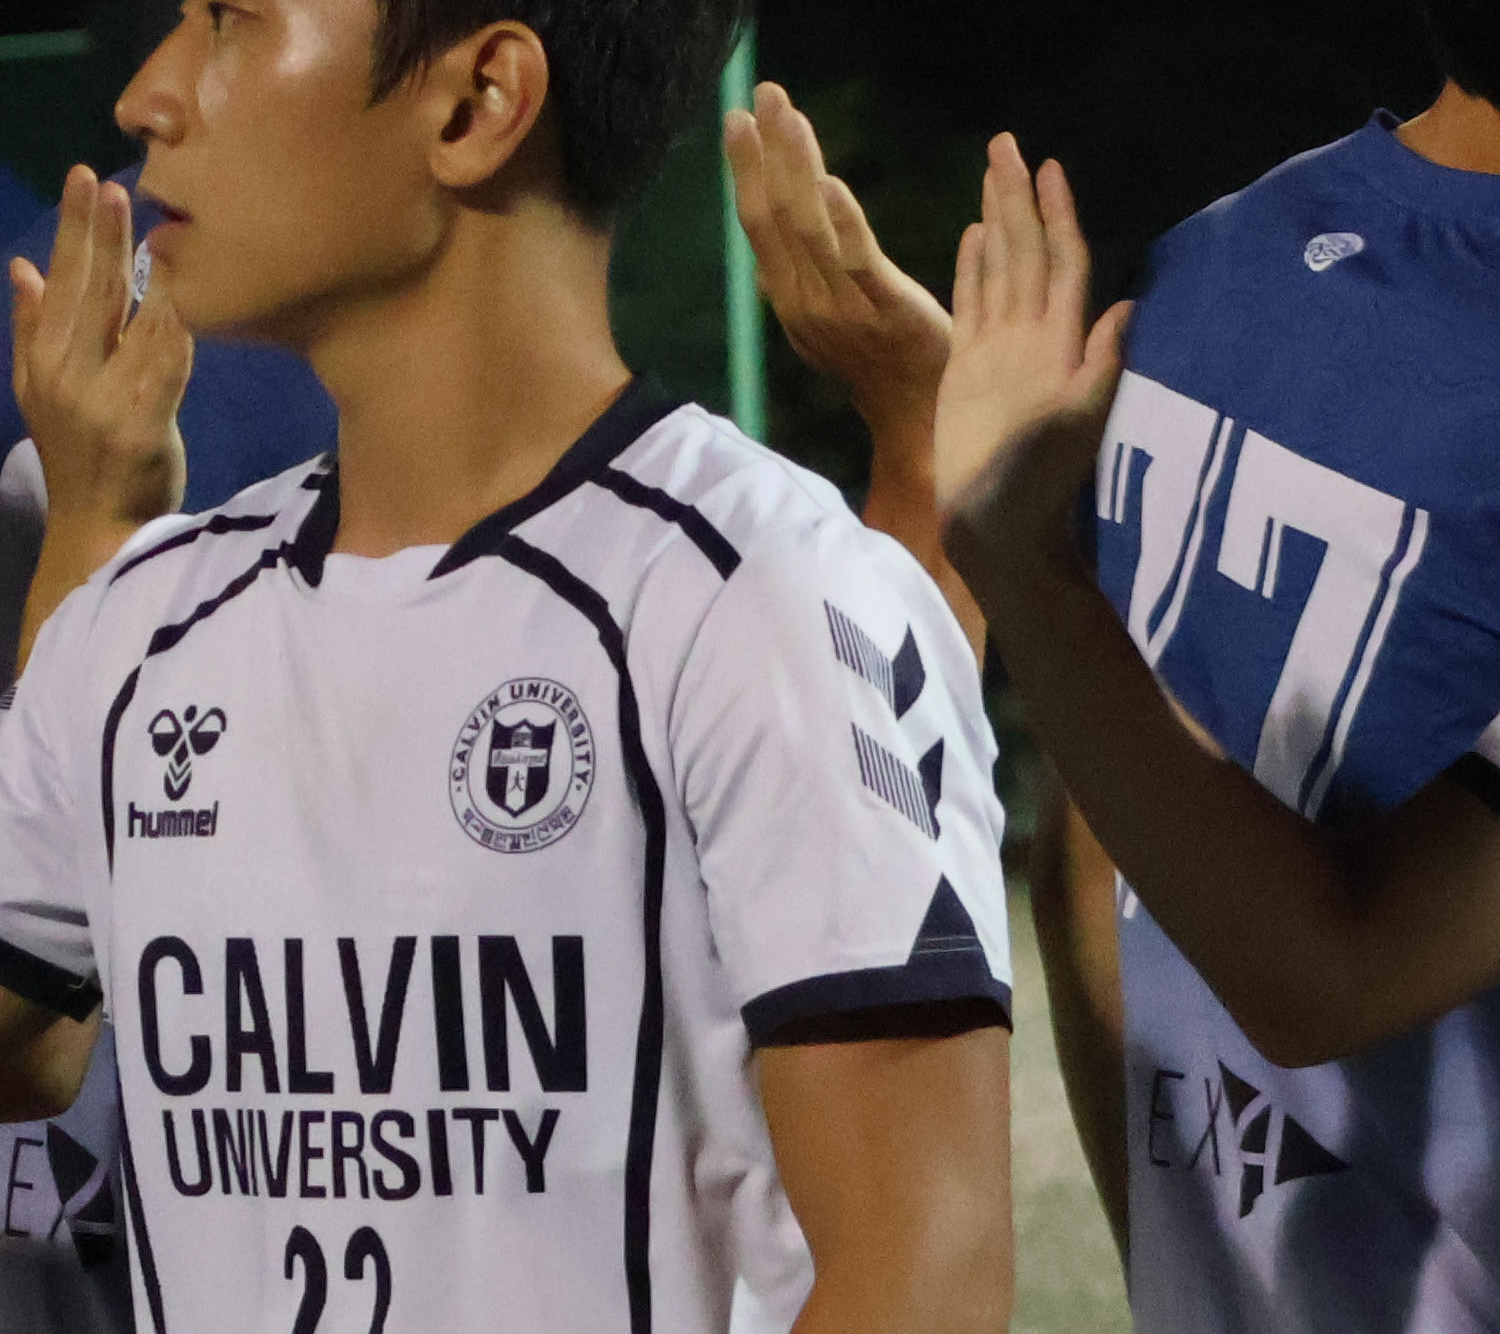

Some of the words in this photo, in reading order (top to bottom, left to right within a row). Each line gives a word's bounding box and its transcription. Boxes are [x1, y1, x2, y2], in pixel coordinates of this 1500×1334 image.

[453, 693, 501, 782] CALVIN
[510, 682, 591, 785] UNIVERSITY
[128, 800, 219, 838] hummel
[137, 934, 589, 1096] CALVIN
[162, 1107, 561, 1202] UNIVERSITY
